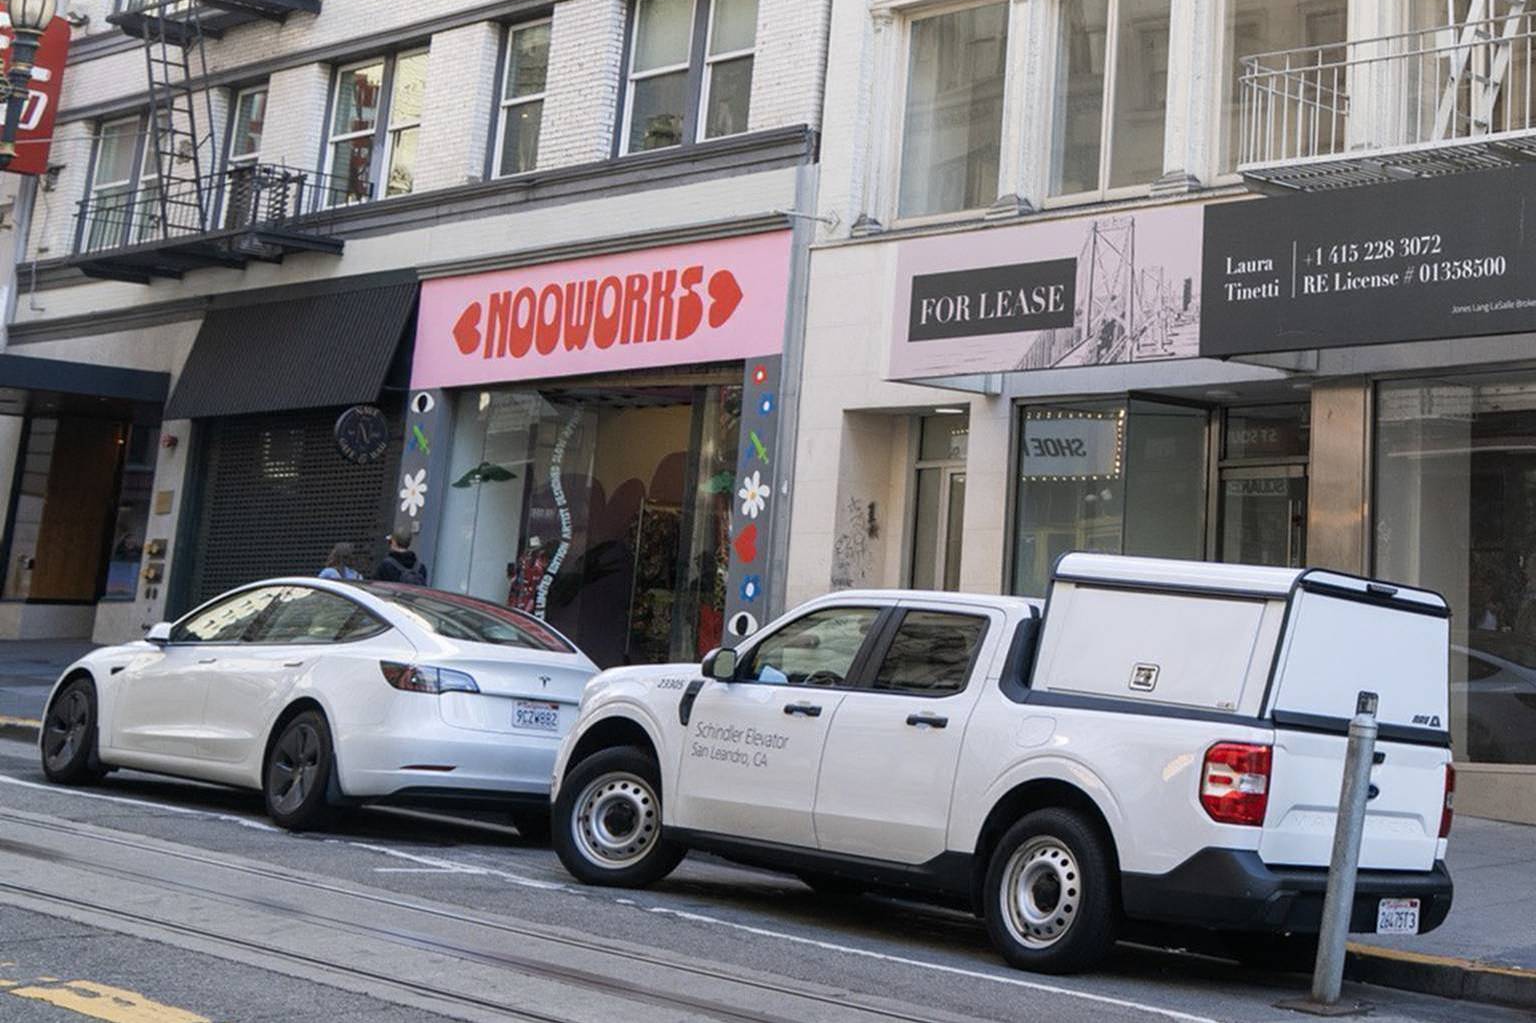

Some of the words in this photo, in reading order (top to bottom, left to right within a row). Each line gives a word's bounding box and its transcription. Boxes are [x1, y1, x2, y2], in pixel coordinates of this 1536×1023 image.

[1303, 248, 1323, 266] +1
[1328, 243, 1359, 265] 415
[1364, 239, 1395, 261] 228
[1400, 234, 1442, 256] 3072
[1226, 257, 1273, 275] Laura
[1303, 273, 1329, 294] RE
[1334, 270, 1400, 291] License
[1403, 265, 1415, 285] #
[1419, 255, 1507, 283] 01358500
[920, 294, 970, 325] FOR
[978, 284, 1065, 320] LEASE
[1224, 279, 1280, 302] Tinetti
[484, 266, 704, 359] NOOWORKS
[695, 721, 744, 743] Schindler
[745, 728, 790, 750] Elevator
[691, 741, 710, 757] San
[710, 745, 749, 767] Leandro,
[753, 751, 768, 767] CA
